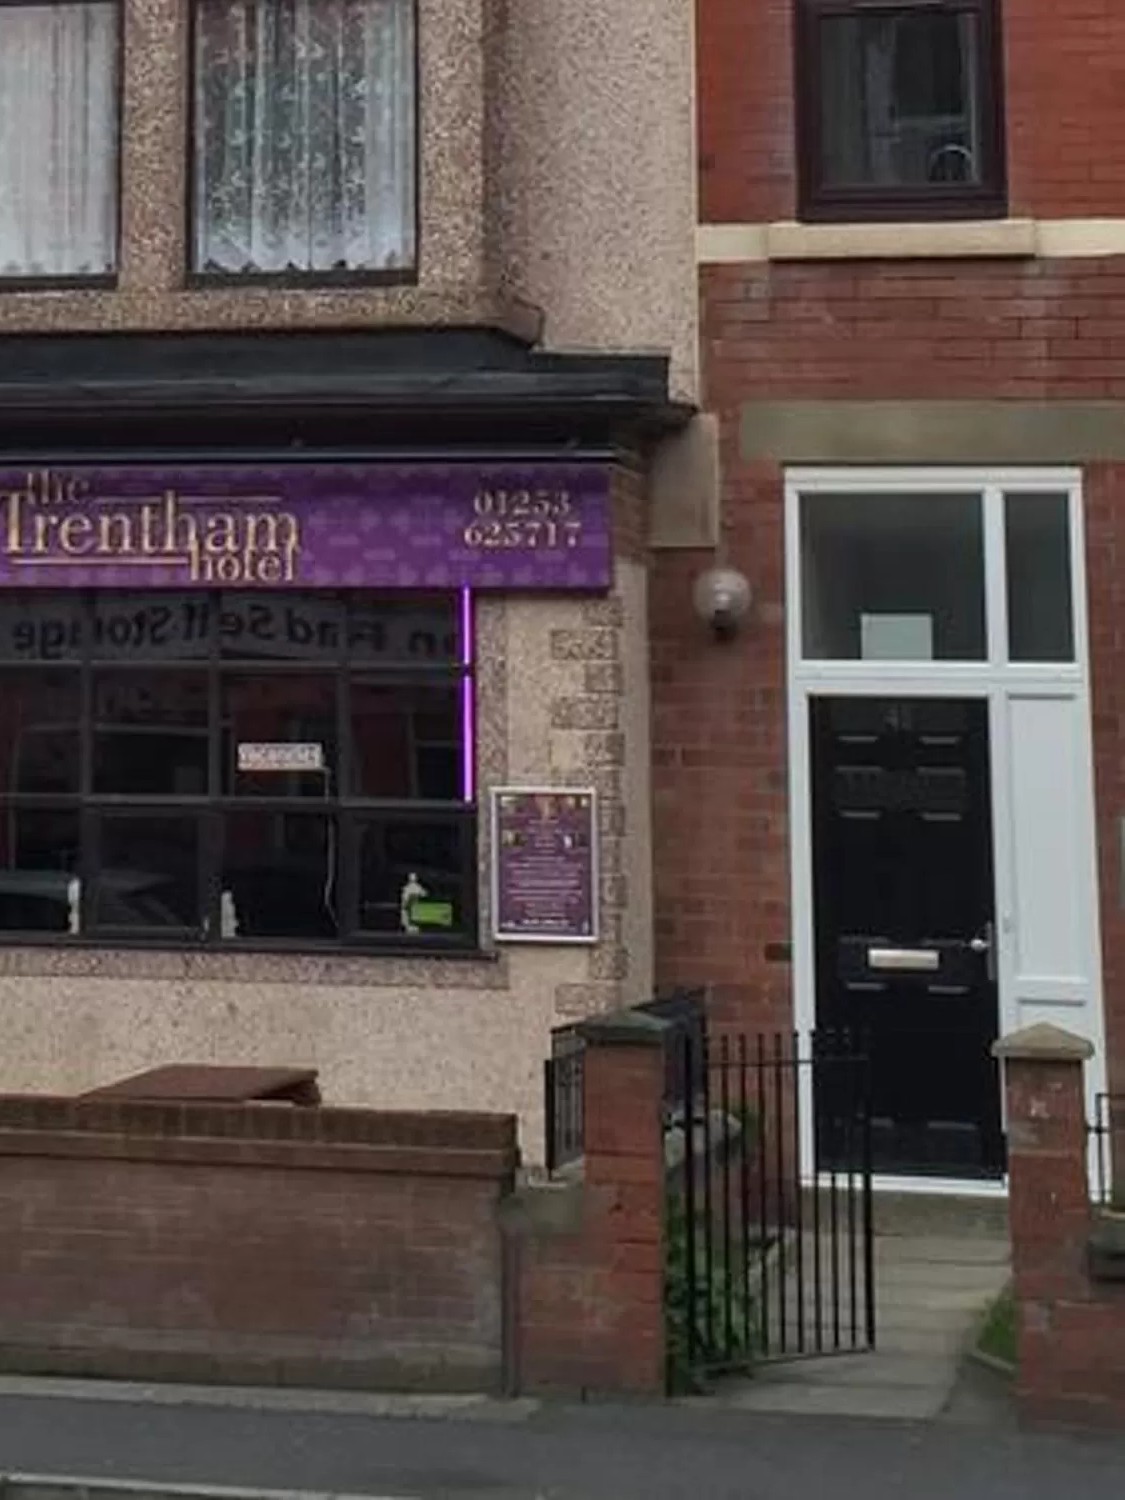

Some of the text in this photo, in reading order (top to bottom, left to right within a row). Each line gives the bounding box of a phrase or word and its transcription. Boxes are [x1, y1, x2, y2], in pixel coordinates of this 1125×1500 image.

[27, 468, 90, 504] the
[473, 490, 571, 516] 01253
[463, 521, 582, 548] 625717
[189, 540, 297, 581] hotel
